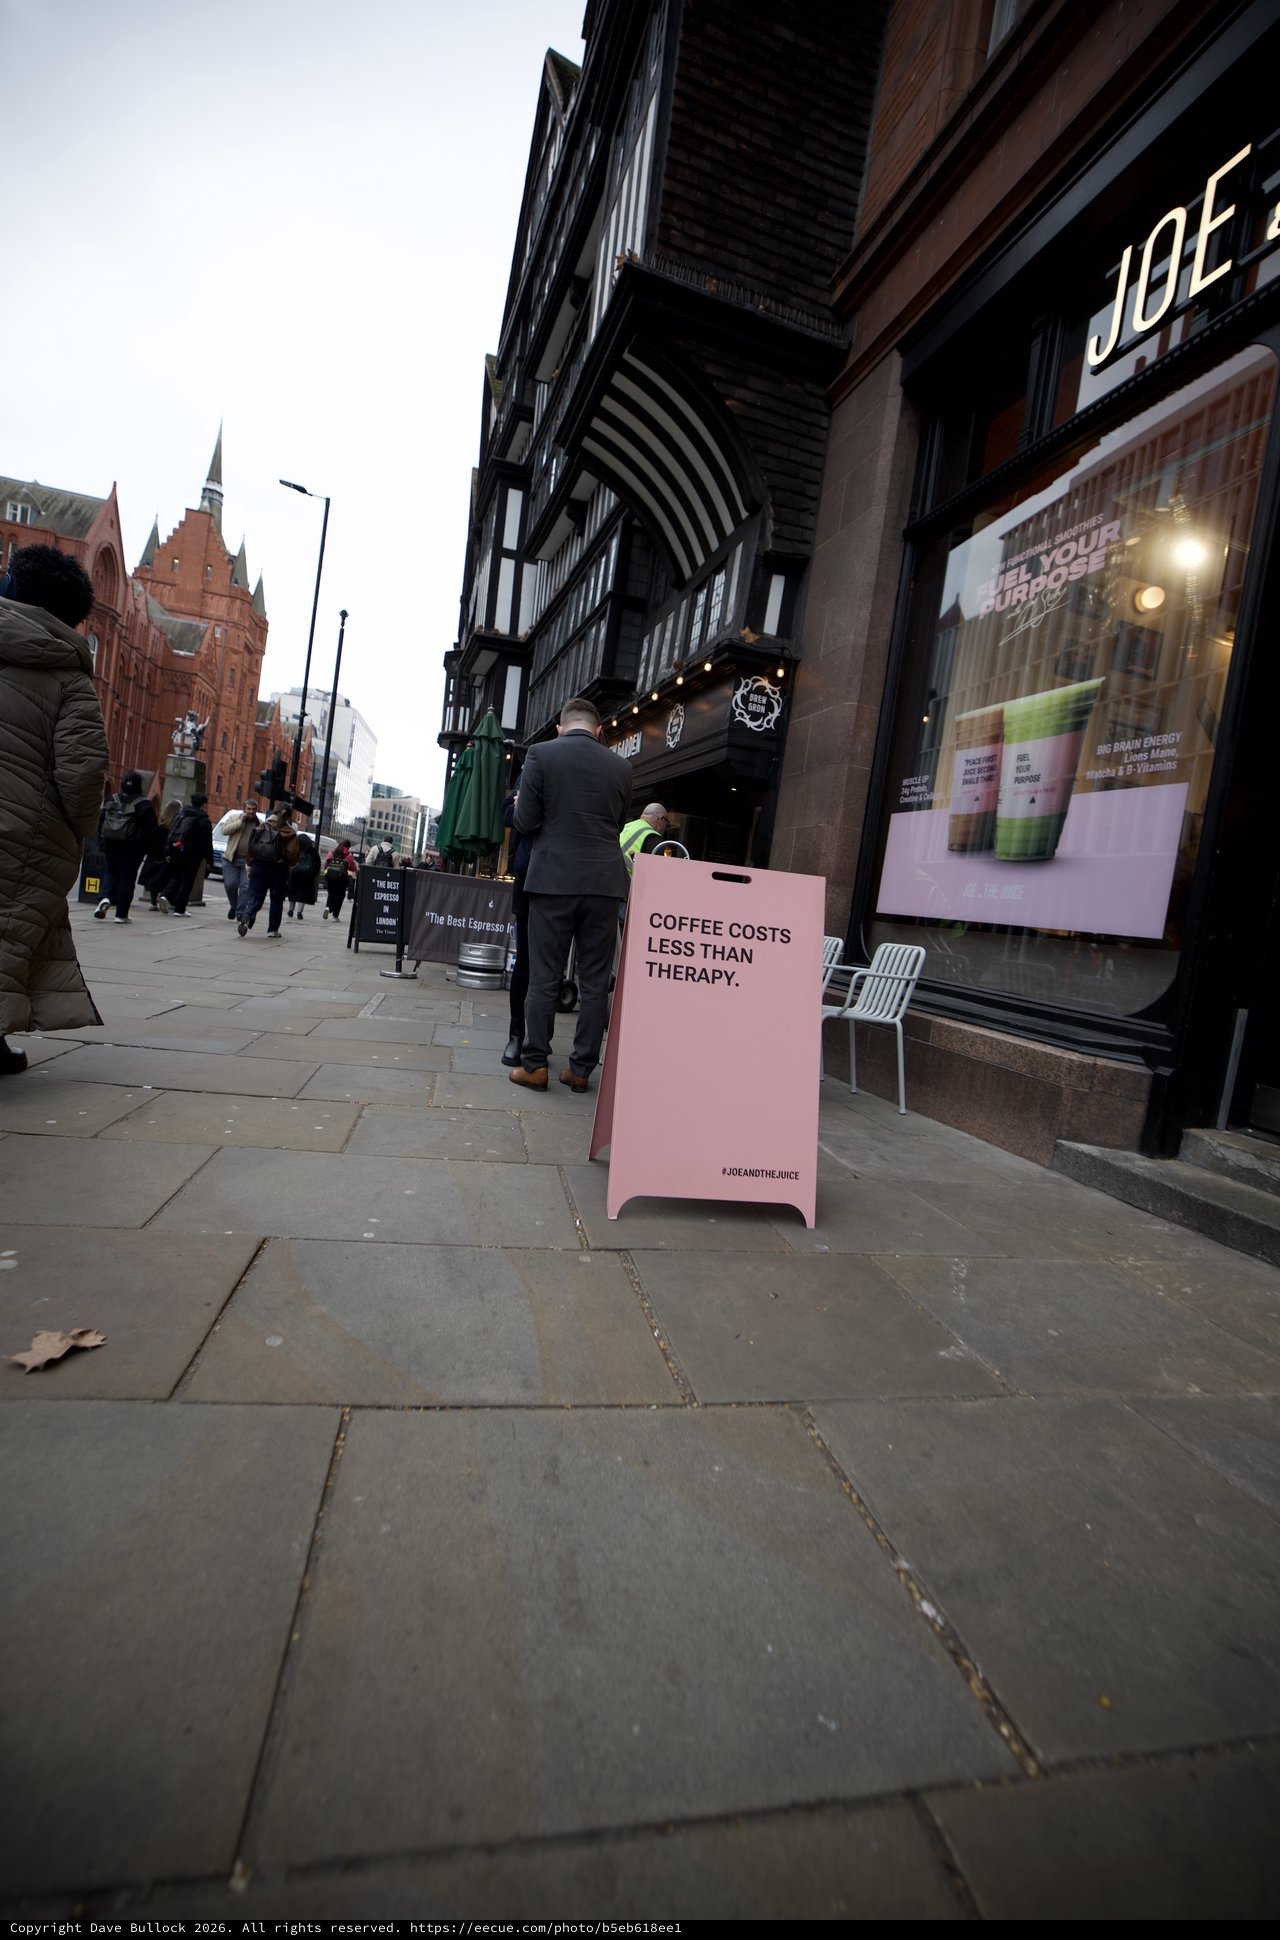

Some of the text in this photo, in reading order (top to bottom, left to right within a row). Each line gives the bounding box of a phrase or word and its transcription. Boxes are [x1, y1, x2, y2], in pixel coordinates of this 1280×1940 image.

[1087, 143, 1252, 366] JOE
[1006, 540, 1052, 568] FUNCTIONAL
[1055, 513, 1103, 544] SMOOTHIES
[976, 520, 1121, 603] FUEL YOUR
[978, 547, 1108, 620] PURPOSE
[749, 693, 768, 705] BREW
[1096, 731, 1183, 755] BIG BRAIN ENERGY
[1016, 753, 1030, 762] FUEL
[1124, 748, 1179, 763] Lions Mane,
[1015, 764, 1031, 773] YOUR
[1086, 760, 1178, 779] Matcha & B-Vitamins
[902, 776, 922, 786] MUSCLE
[1014, 774, 1041, 785] PURPOSE
[87, 879, 98, 891] H
[386, 881, 399, 890] BEST
[963, 883, 1025, 900] JOE THE JUICE
[374, 892, 399, 902] ESPRESSO
[383, 905, 389, 913] IN
[425, 911, 444, 925] "The
[447, 915, 466, 928] Best
[468, 918, 504, 933] Espresso
[649, 913, 791, 944] COFFEE COSTS
[647, 937, 753, 964] LESS THAN
[645, 961, 739, 987] THERAPY.
[722, 1167, 799, 1180] #JOEANDTHEJUICE
